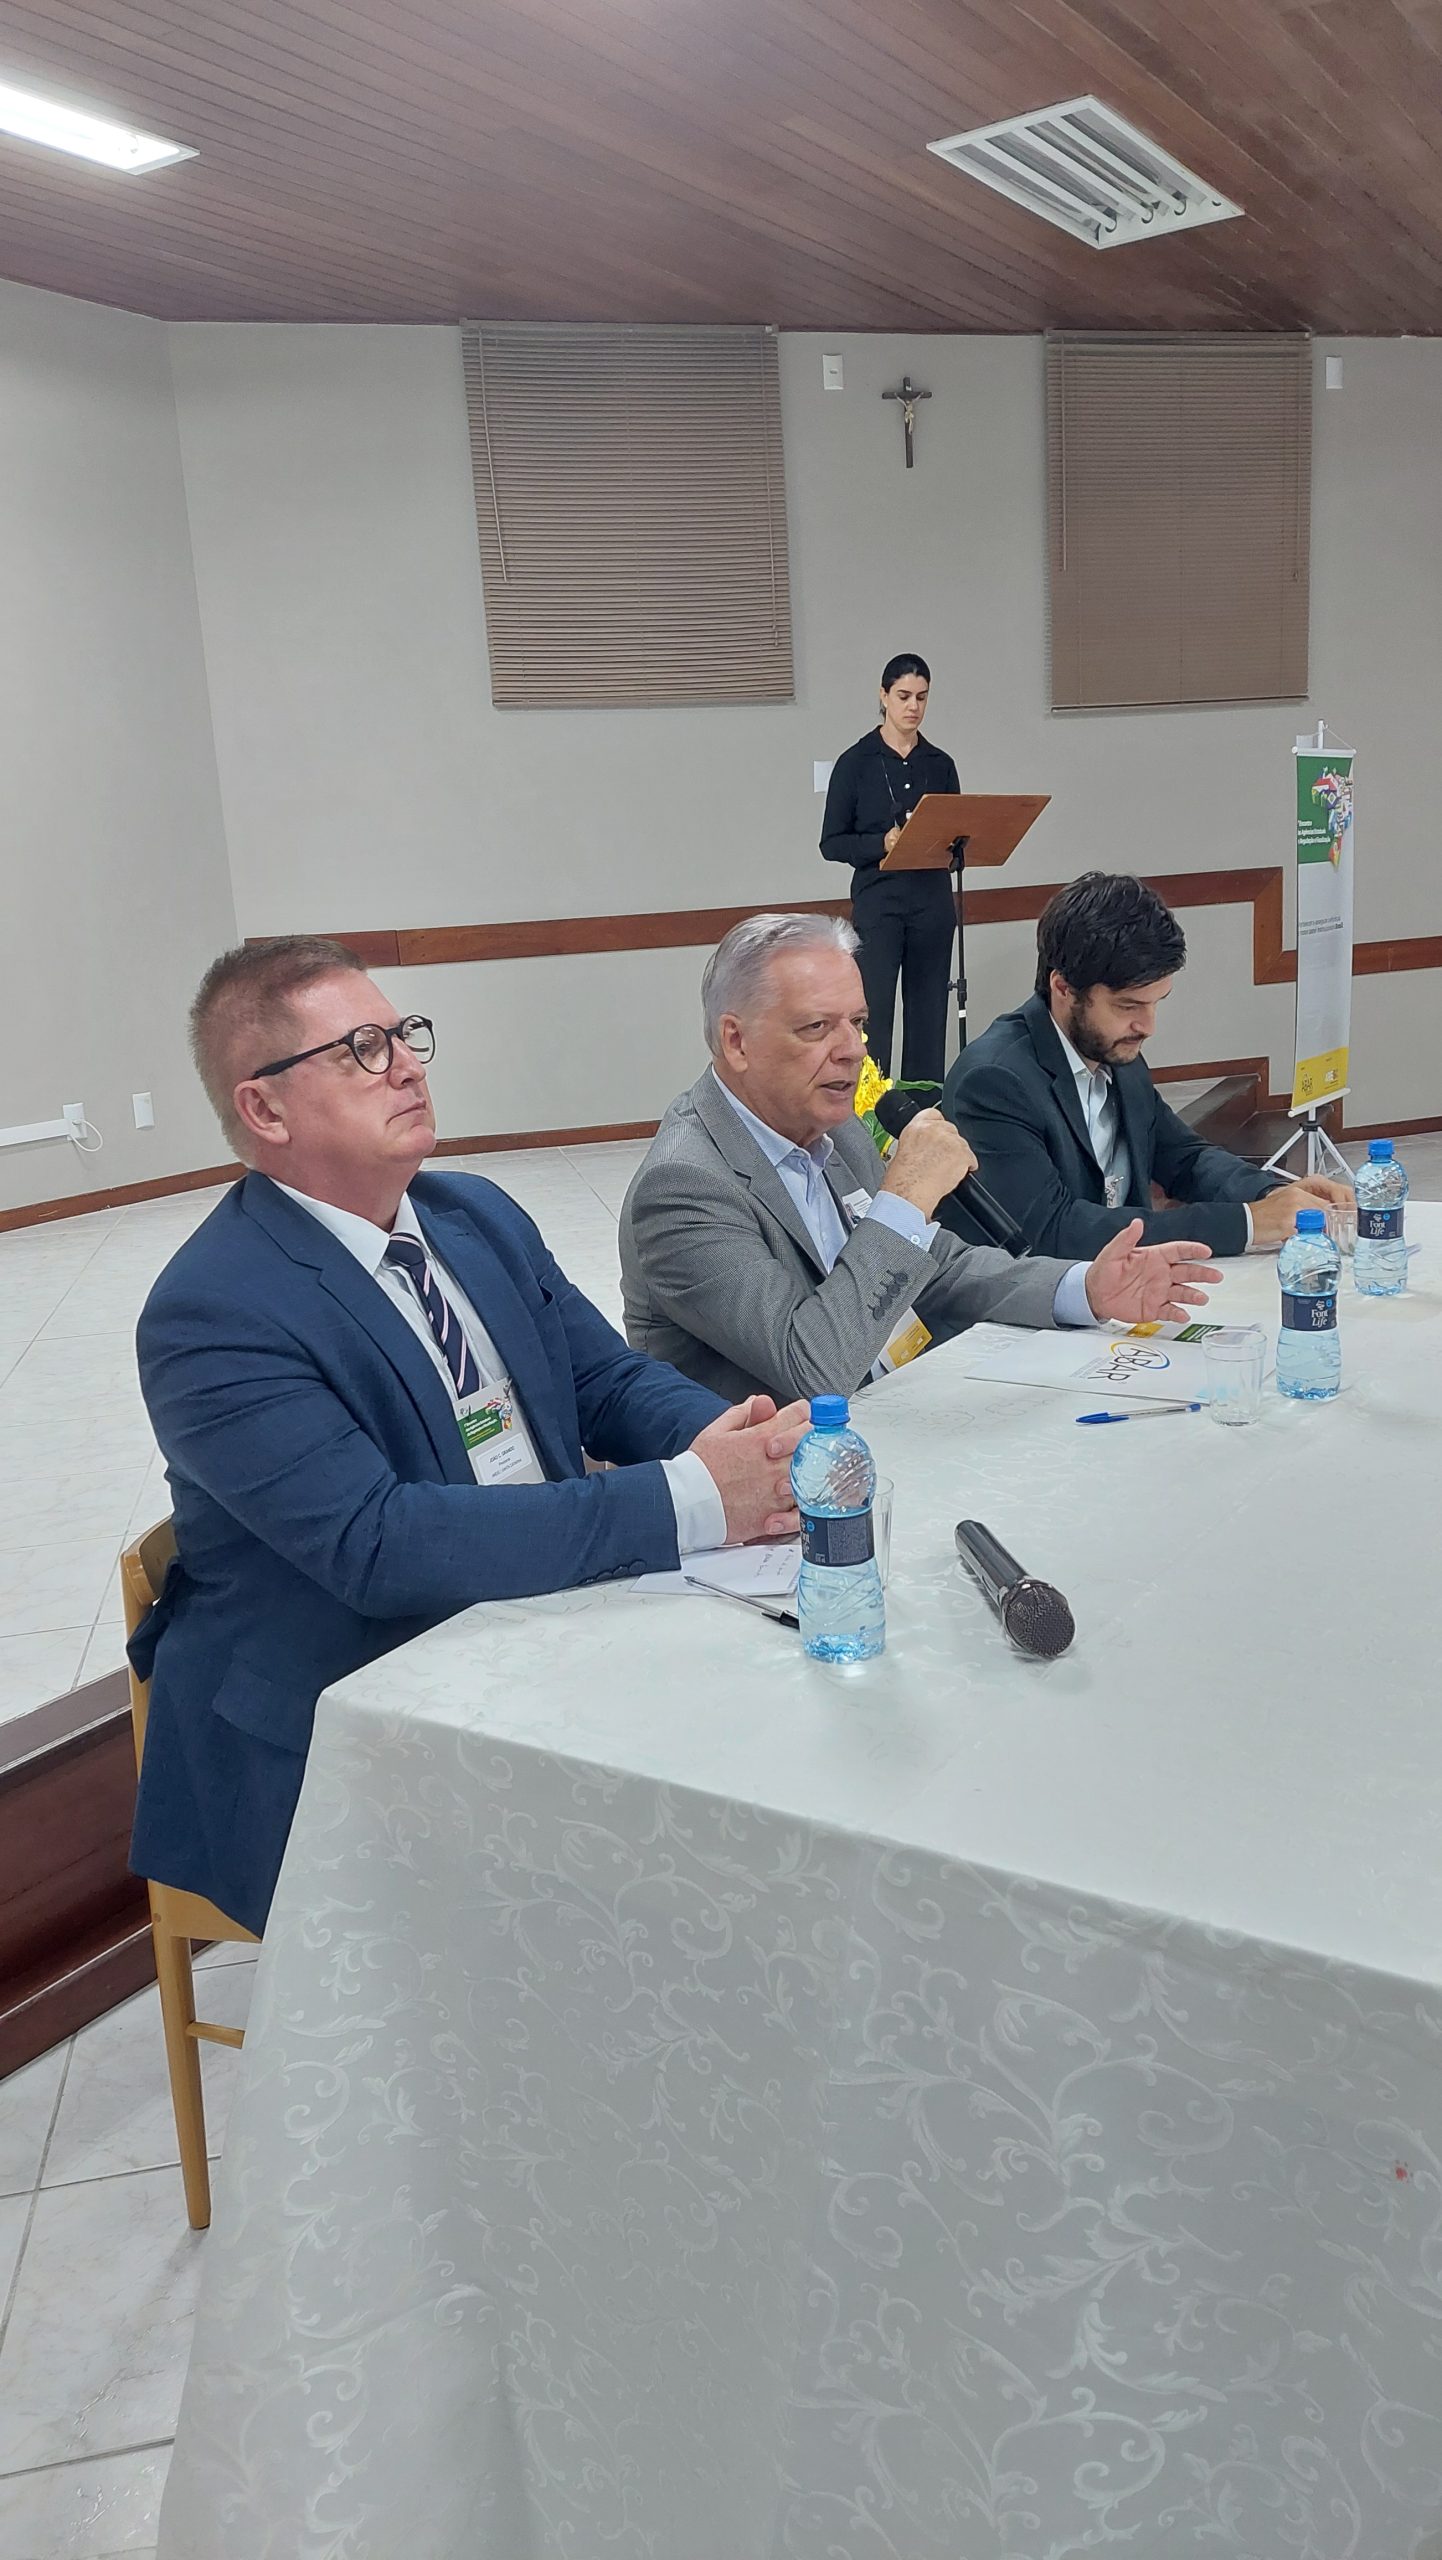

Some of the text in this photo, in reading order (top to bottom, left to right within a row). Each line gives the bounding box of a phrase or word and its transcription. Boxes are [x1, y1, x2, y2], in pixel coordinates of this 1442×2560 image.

[1370, 1220, 1386, 1228] Font
[1370, 1227, 1385, 1237] Life
[1311, 1309, 1329, 1318] Font
[1312, 1316, 1328, 1328] Life
[1087, 1347, 1160, 1381] ABAR
